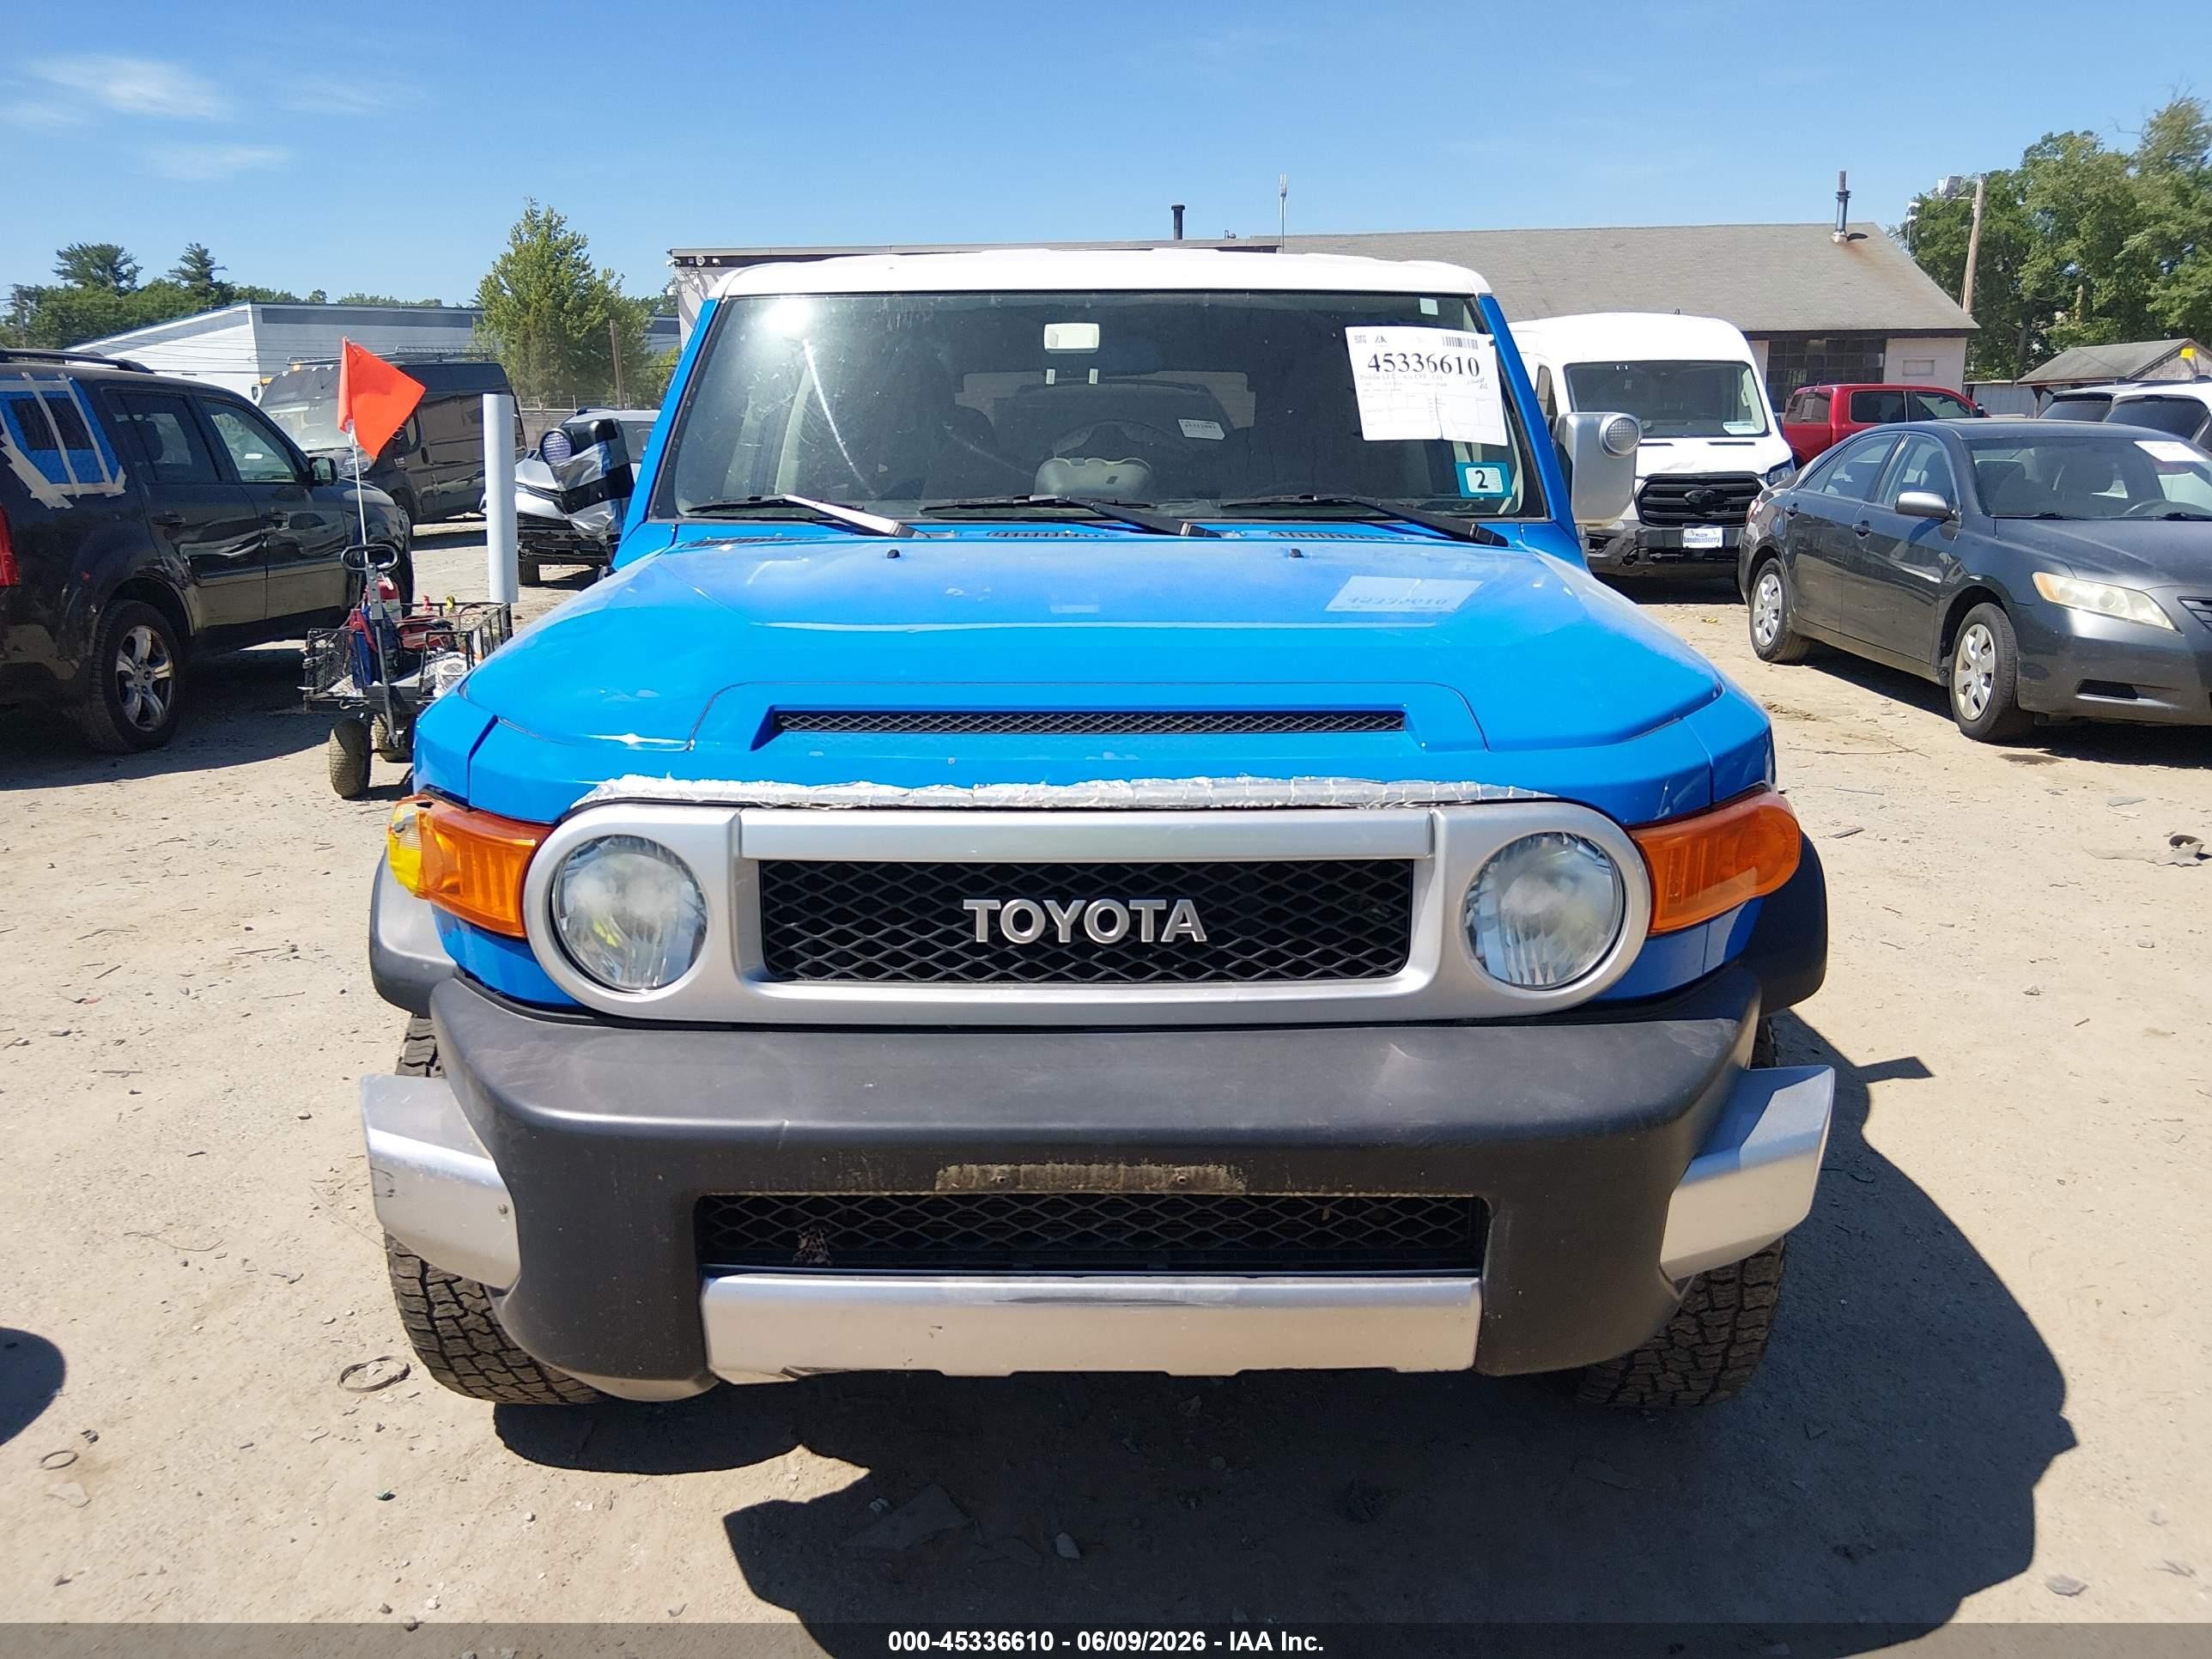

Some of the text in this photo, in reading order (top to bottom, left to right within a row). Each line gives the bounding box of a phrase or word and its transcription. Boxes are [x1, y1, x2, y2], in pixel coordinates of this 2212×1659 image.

[1367, 351, 1480, 377] 45336610
[1474, 470, 1488, 489] 2
[963, 898, 1207, 945] TOYOTA
